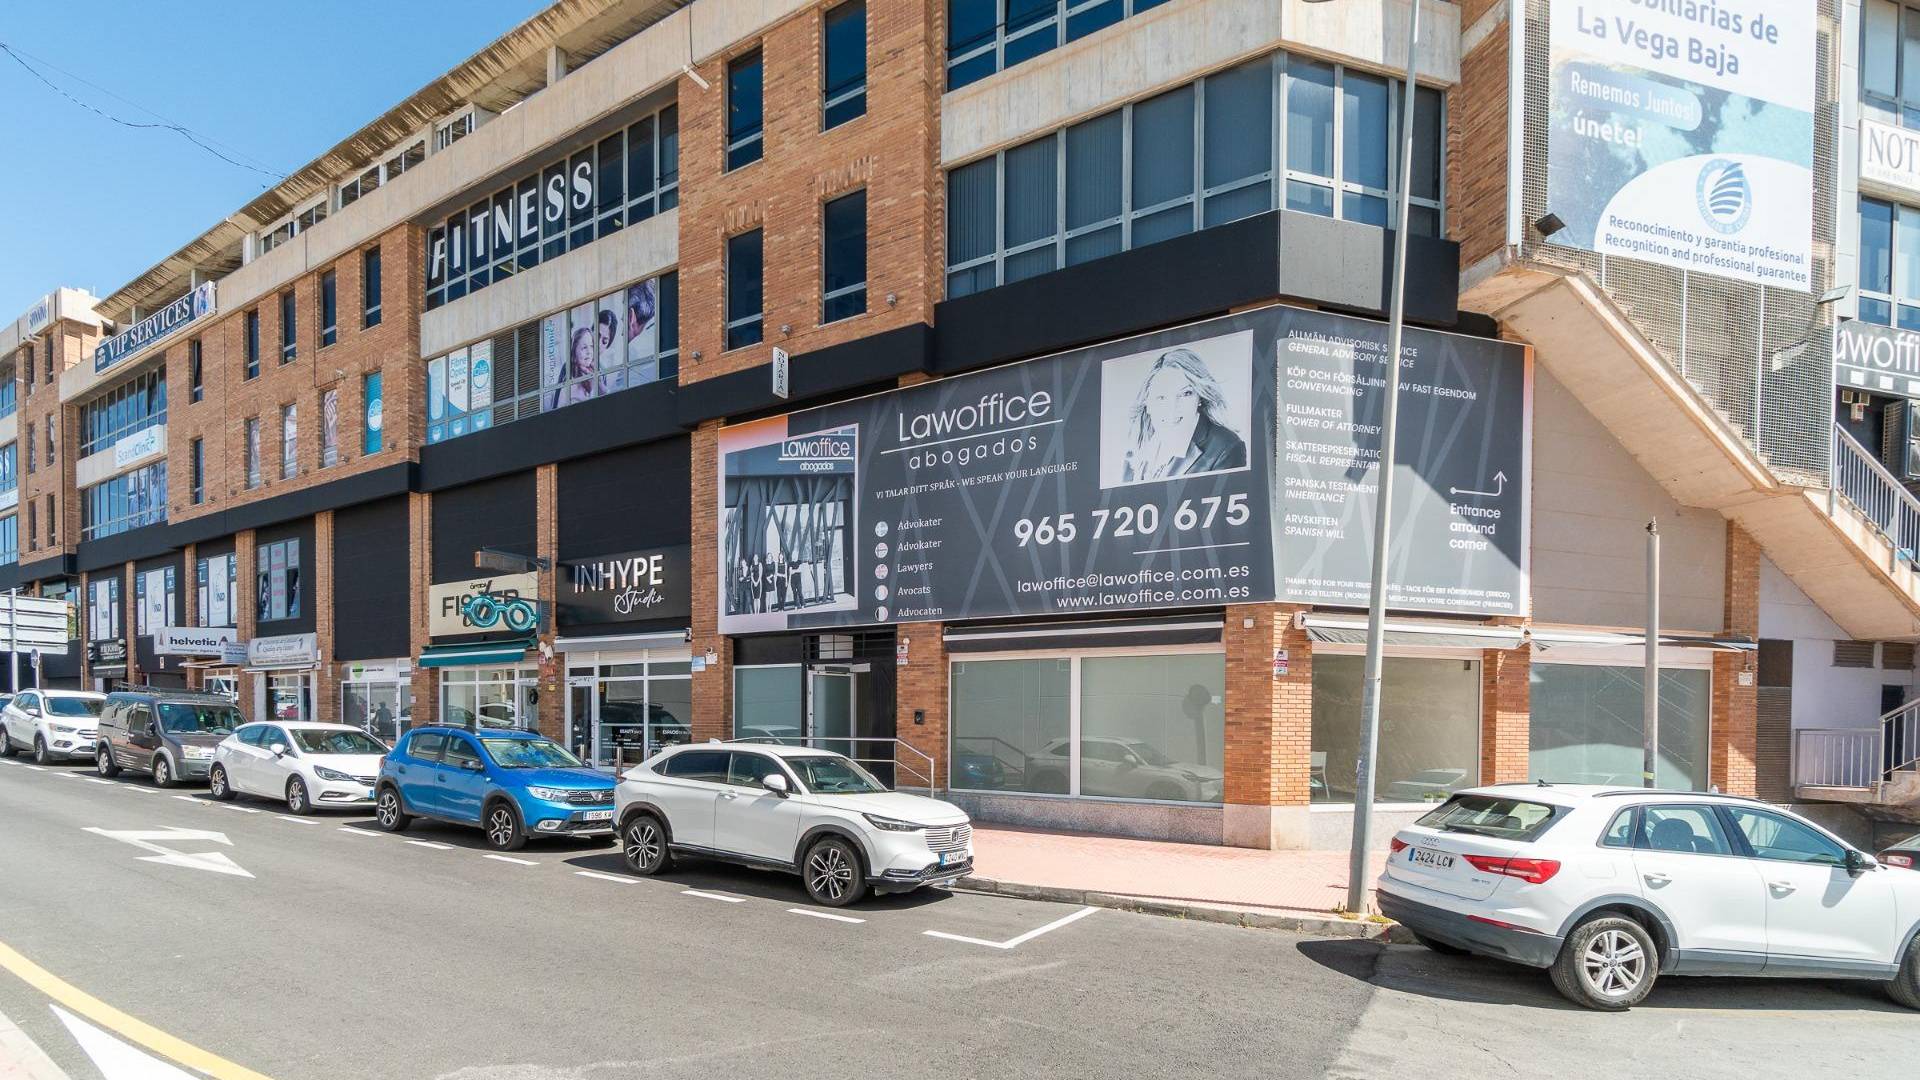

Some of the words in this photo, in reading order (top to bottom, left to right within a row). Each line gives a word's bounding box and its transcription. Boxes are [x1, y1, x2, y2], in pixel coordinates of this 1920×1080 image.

[1629, 0, 1742, 34] iliarias
[1750, 13, 1778, 45] de
[1577, 6, 1606, 39] La
[1615, 16, 1680, 60] Vega
[1688, 37, 1739, 77] Baja
[1570, 71, 1641, 108] Rememos
[1573, 112, 1643, 149] únete!
[431, 161, 592, 280] FITNESS
[1609, 214, 1693, 245] Reconocimiento
[1696, 234, 1702, 249] y
[1749, 245, 1805, 265] profesional
[1605, 233, 1669, 259] Recognition
[1672, 246, 1690, 261] and
[1693, 250, 1755, 274] professional
[1756, 261, 1807, 284] guarantee
[108, 333, 128, 359] VIP
[130, 296, 190, 348] SERVICES
[1288, 342, 1329, 356] GENERAL
[1331, 348, 1377, 362] ADVISORY
[1328, 335, 1380, 351] ADVISORISK
[1287, 379, 1364, 397] CONVEYANCING
[1308, 369, 1331, 380] OCH
[1399, 383, 1411, 391] AV
[1412, 384, 1432, 394] FAST
[1434, 386, 1477, 401] EGENDOM
[899, 390, 1051, 442] Lawoffice
[1286, 403, 1342, 418] FULLMAKTER
[1286, 416, 1320, 429] POWER
[1322, 420, 1335, 430] OF
[1336, 422, 1382, 435] ATTORNEY
[909, 436, 1037, 470] abogados
[1285, 453, 1317, 464] FISCAL
[800, 461, 834, 472] abogados
[885, 488, 909, 499] TALAR
[910, 485, 928, 495] DITT
[929, 478, 955, 493] SPRÅK
[962, 478, 975, 488] WE
[977, 472, 1003, 487] SPEAK
[1005, 468, 1028, 480] YOUR
[1030, 461, 1078, 477] LANGUAGE
[1284, 477, 1326, 489] SPANSKA
[1285, 489, 1345, 503] INHERITANCE
[1450, 502, 1501, 519] Entrance
[898, 517, 942, 531] Advokater
[1014, 513, 1077, 547] 965
[1091, 503, 1159, 540] 720
[1173, 493, 1250, 530] 675
[1284, 514, 1338, 526] ARVSKIFTEN
[1284, 526, 1324, 537] SPANISH
[1326, 529, 1345, 539] WILL
[898, 539, 942, 552] Advokater
[1449, 538, 1488, 551] corner
[574, 554, 663, 593] INHYPE
[897, 561, 933, 573] Lawyers
[1017, 564, 1250, 593] lawoffice@lawoffice.com.es
[1308, 578, 1321, 586] YOU
[1323, 579, 1335, 587] FOR
[1337, 580, 1353, 588] YOUR
[614, 585, 665, 614] Studio
[898, 585, 931, 596] Avocats
[1057, 585, 1250, 608] www.lawoffice.com.es
[898, 606, 942, 618] Advocaten
[170, 636, 216, 646] helvetia
[1415, 850, 1436, 865] 2424
